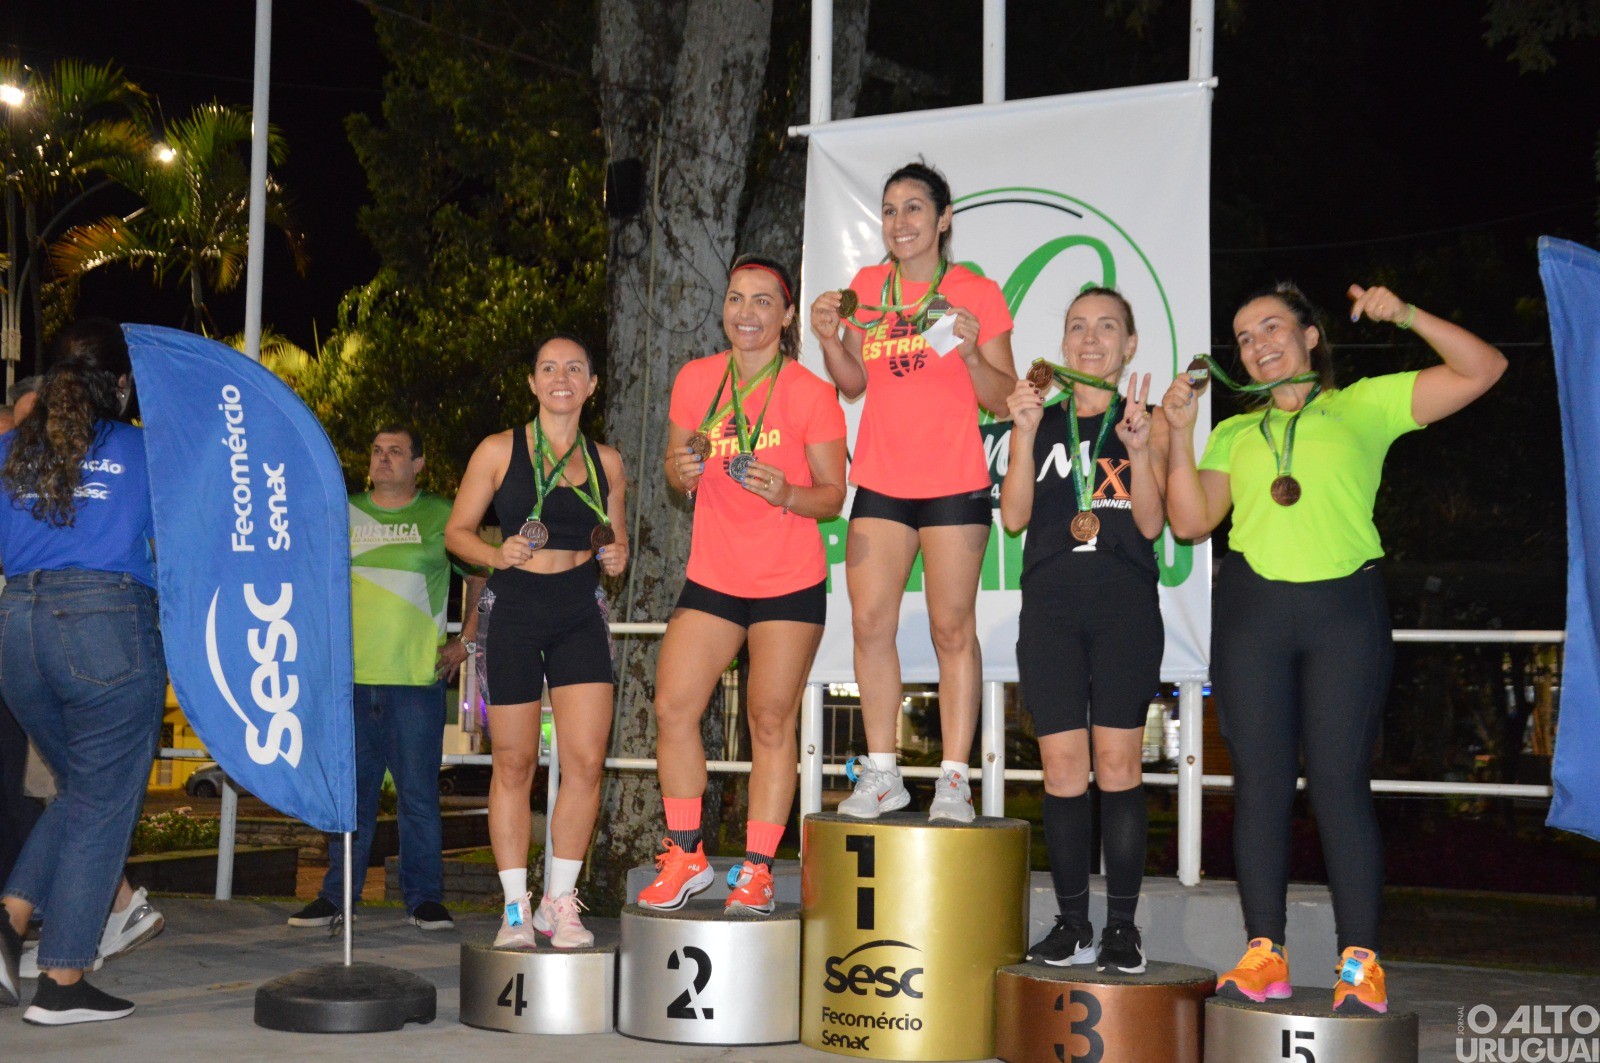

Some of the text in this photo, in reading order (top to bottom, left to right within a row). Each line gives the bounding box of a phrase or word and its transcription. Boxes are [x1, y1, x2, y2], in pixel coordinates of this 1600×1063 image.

[862, 335, 931, 361] ESTRA
[709, 429, 781, 458] STRDA
[221, 385, 255, 552] Fecomércio
[263, 463, 290, 551] Senac
[352, 521, 420, 538] RÚSTICA
[846, 834, 875, 931] 1
[497, 973, 528, 1017] 4
[667, 945, 714, 1020] 2
[822, 1006, 923, 1032] Fecomércio
[1053, 989, 1105, 1063] 3
[821, 1029, 870, 1051] Senac
[1281, 1029, 1316, 1063] 5
